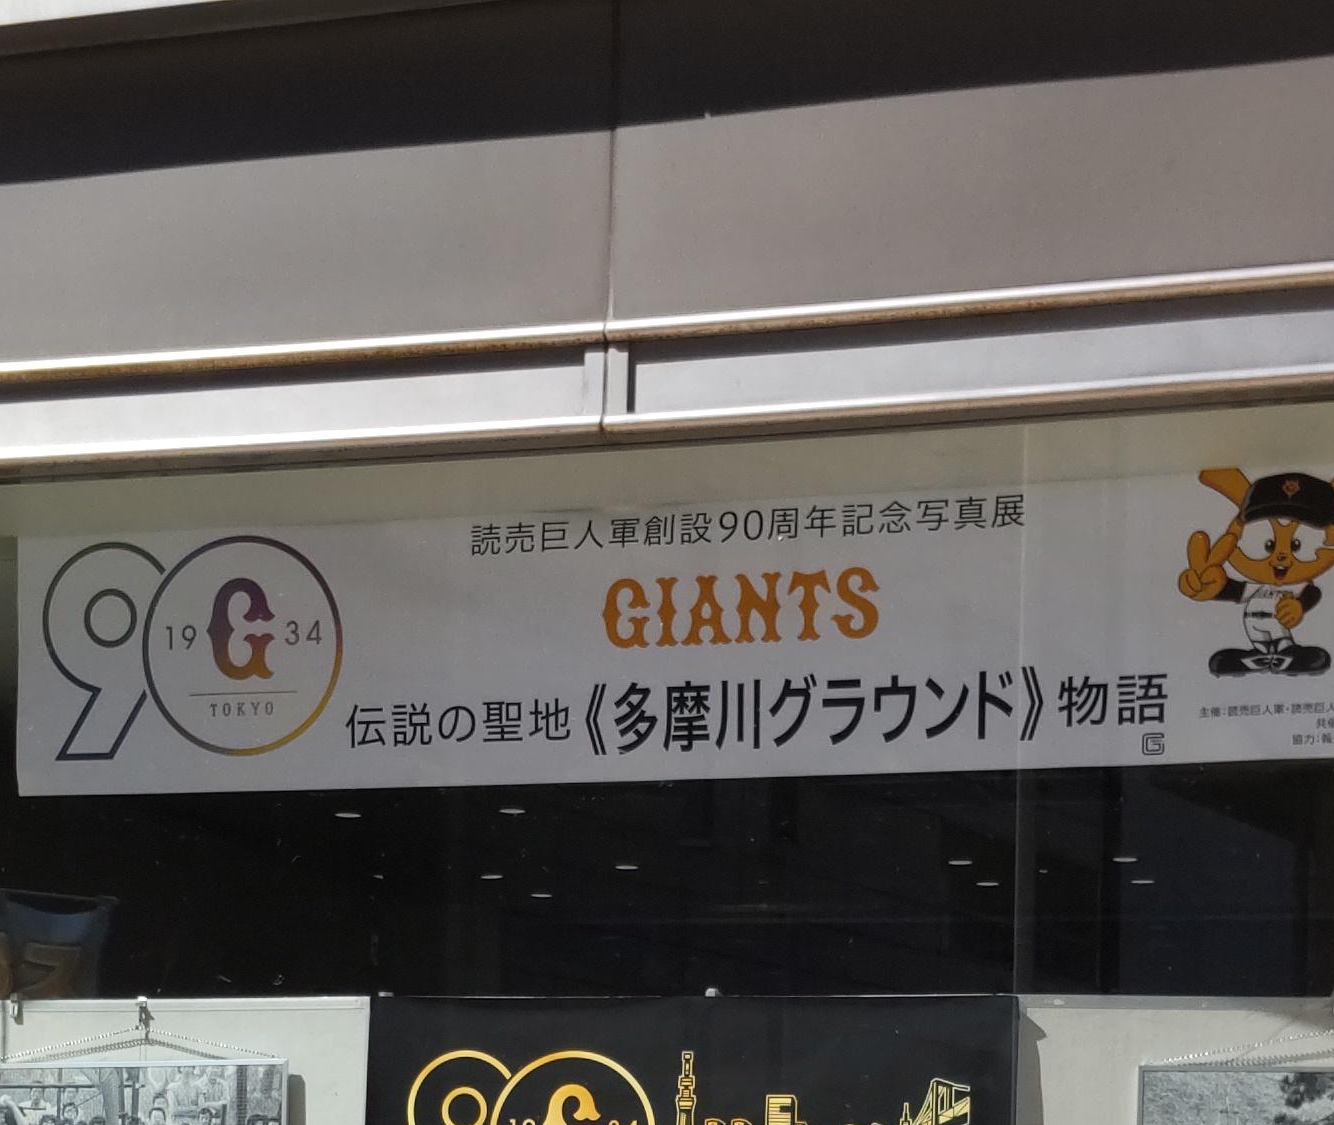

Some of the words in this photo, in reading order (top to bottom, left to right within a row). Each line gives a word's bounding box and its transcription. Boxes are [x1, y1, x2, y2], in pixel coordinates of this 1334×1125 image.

[470, 494, 1025, 555] 読売巨人軍創設90周年記念写真展
[601, 566, 881, 649] GIANTS
[209, 701, 275, 718] TOKYO
